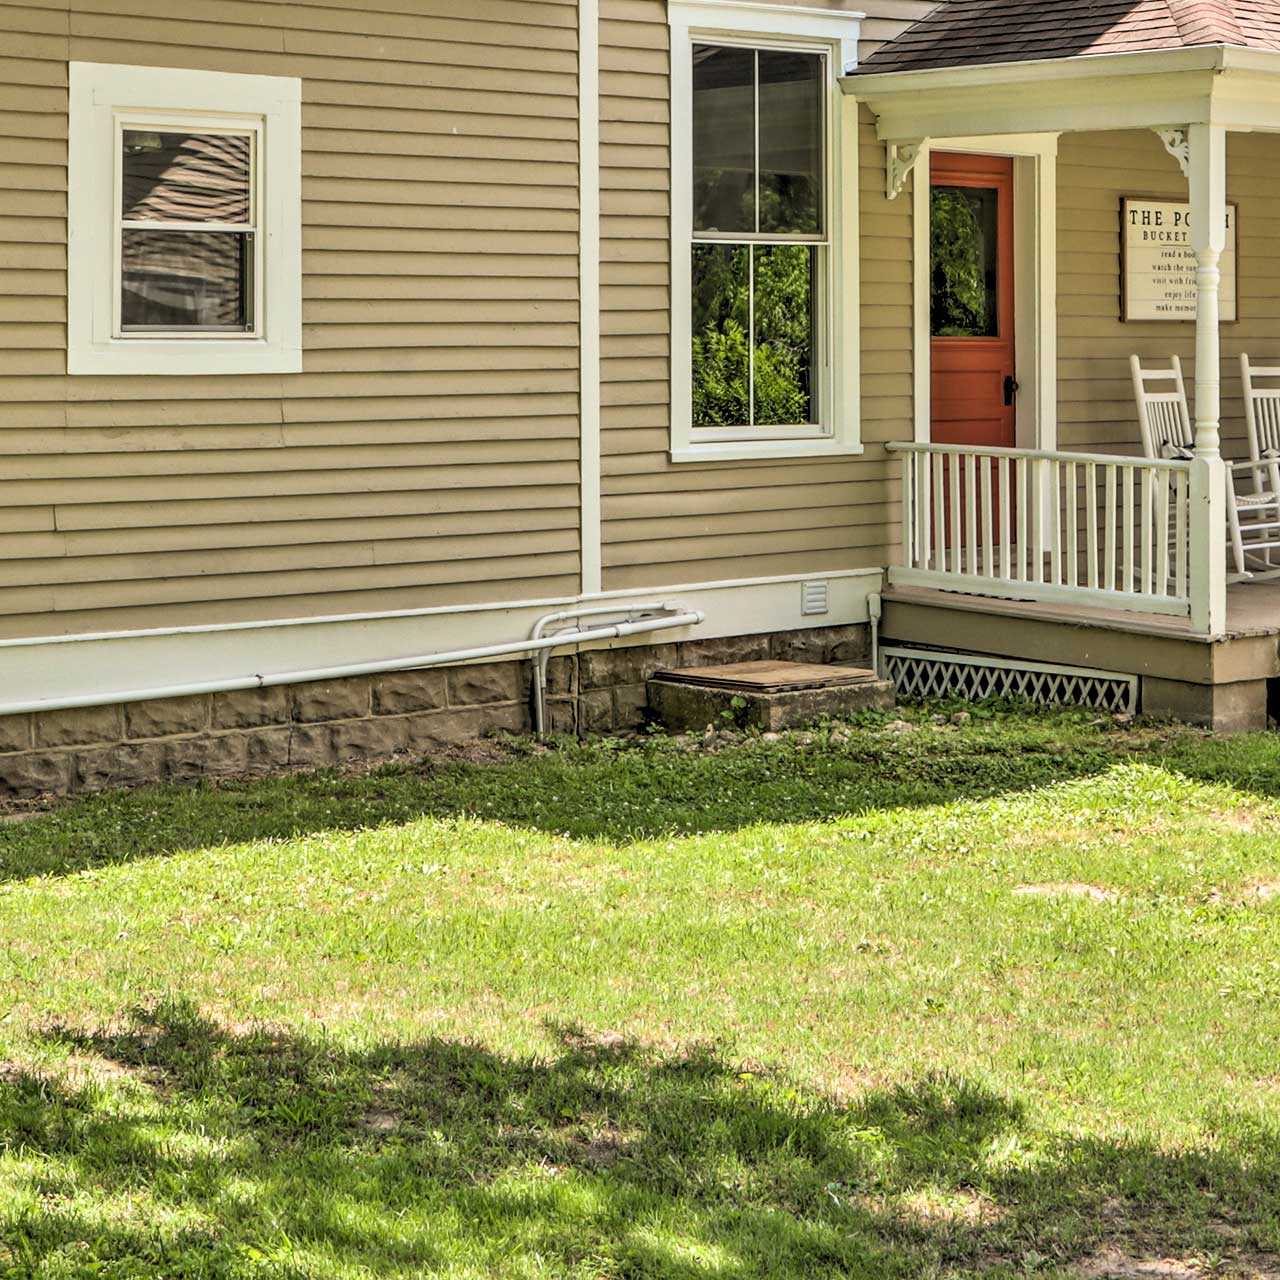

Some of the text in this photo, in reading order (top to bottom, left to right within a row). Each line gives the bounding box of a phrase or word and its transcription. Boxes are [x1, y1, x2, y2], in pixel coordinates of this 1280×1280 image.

[1129, 209, 1163, 226] THE
[1143, 231, 1187, 242] BUCKET
[1161, 250, 1176, 258] read
[1184, 250, 1197, 258] boo
[1152, 263, 1172, 271] watch
[1174, 263, 1184, 271] the
[1152, 277, 1167, 285] visit
[1169, 276, 1183, 285] with
[1165, 290, 1196, 301] enjoy life
[1156, 303, 1172, 312] make
